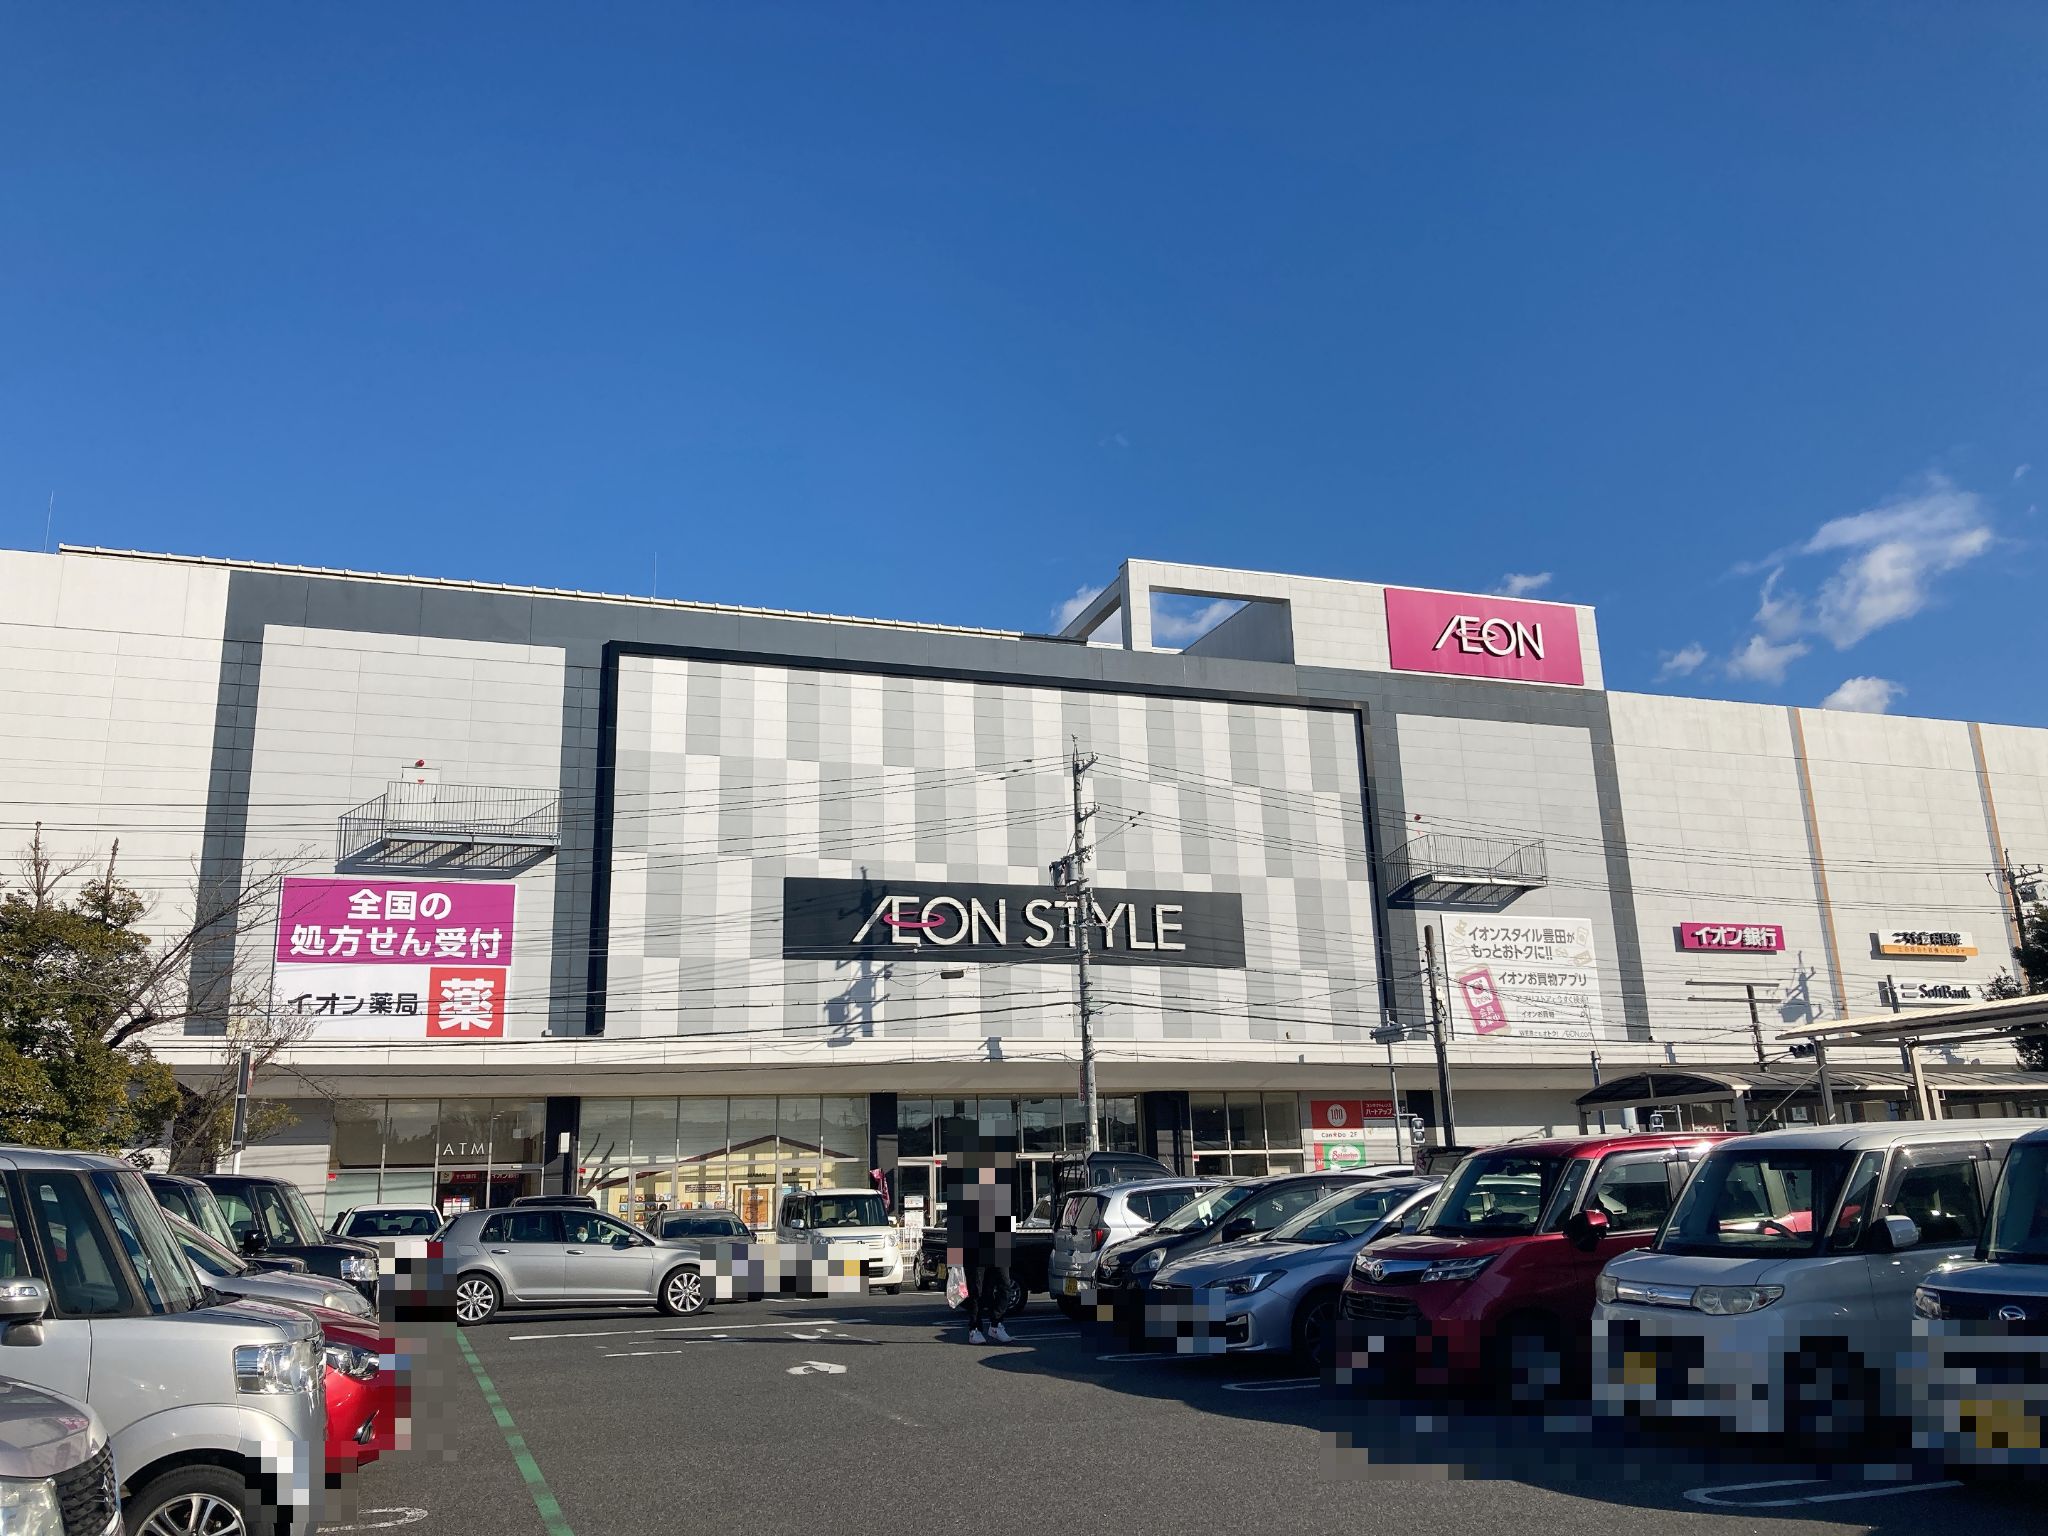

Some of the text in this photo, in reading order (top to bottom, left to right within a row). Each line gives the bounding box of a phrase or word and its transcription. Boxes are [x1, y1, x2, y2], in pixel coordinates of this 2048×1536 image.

[347, 888, 452, 920] 全国の
[1024, 898, 1187, 951] STYLE
[1468, 926, 1576, 944] イオンスタイル豊田が
[289, 924, 503, 959] 処方せん受付
[1695, 926, 1777, 947] イオン銀行
[1498, 971, 1587, 987] イオンお買物アプリ
[1919, 984, 1972, 999] SoftBank
[287, 992, 418, 1015] イオン薬局
[437, 978, 494, 1031] 薬
[443, 1143, 485, 1156] ATM
